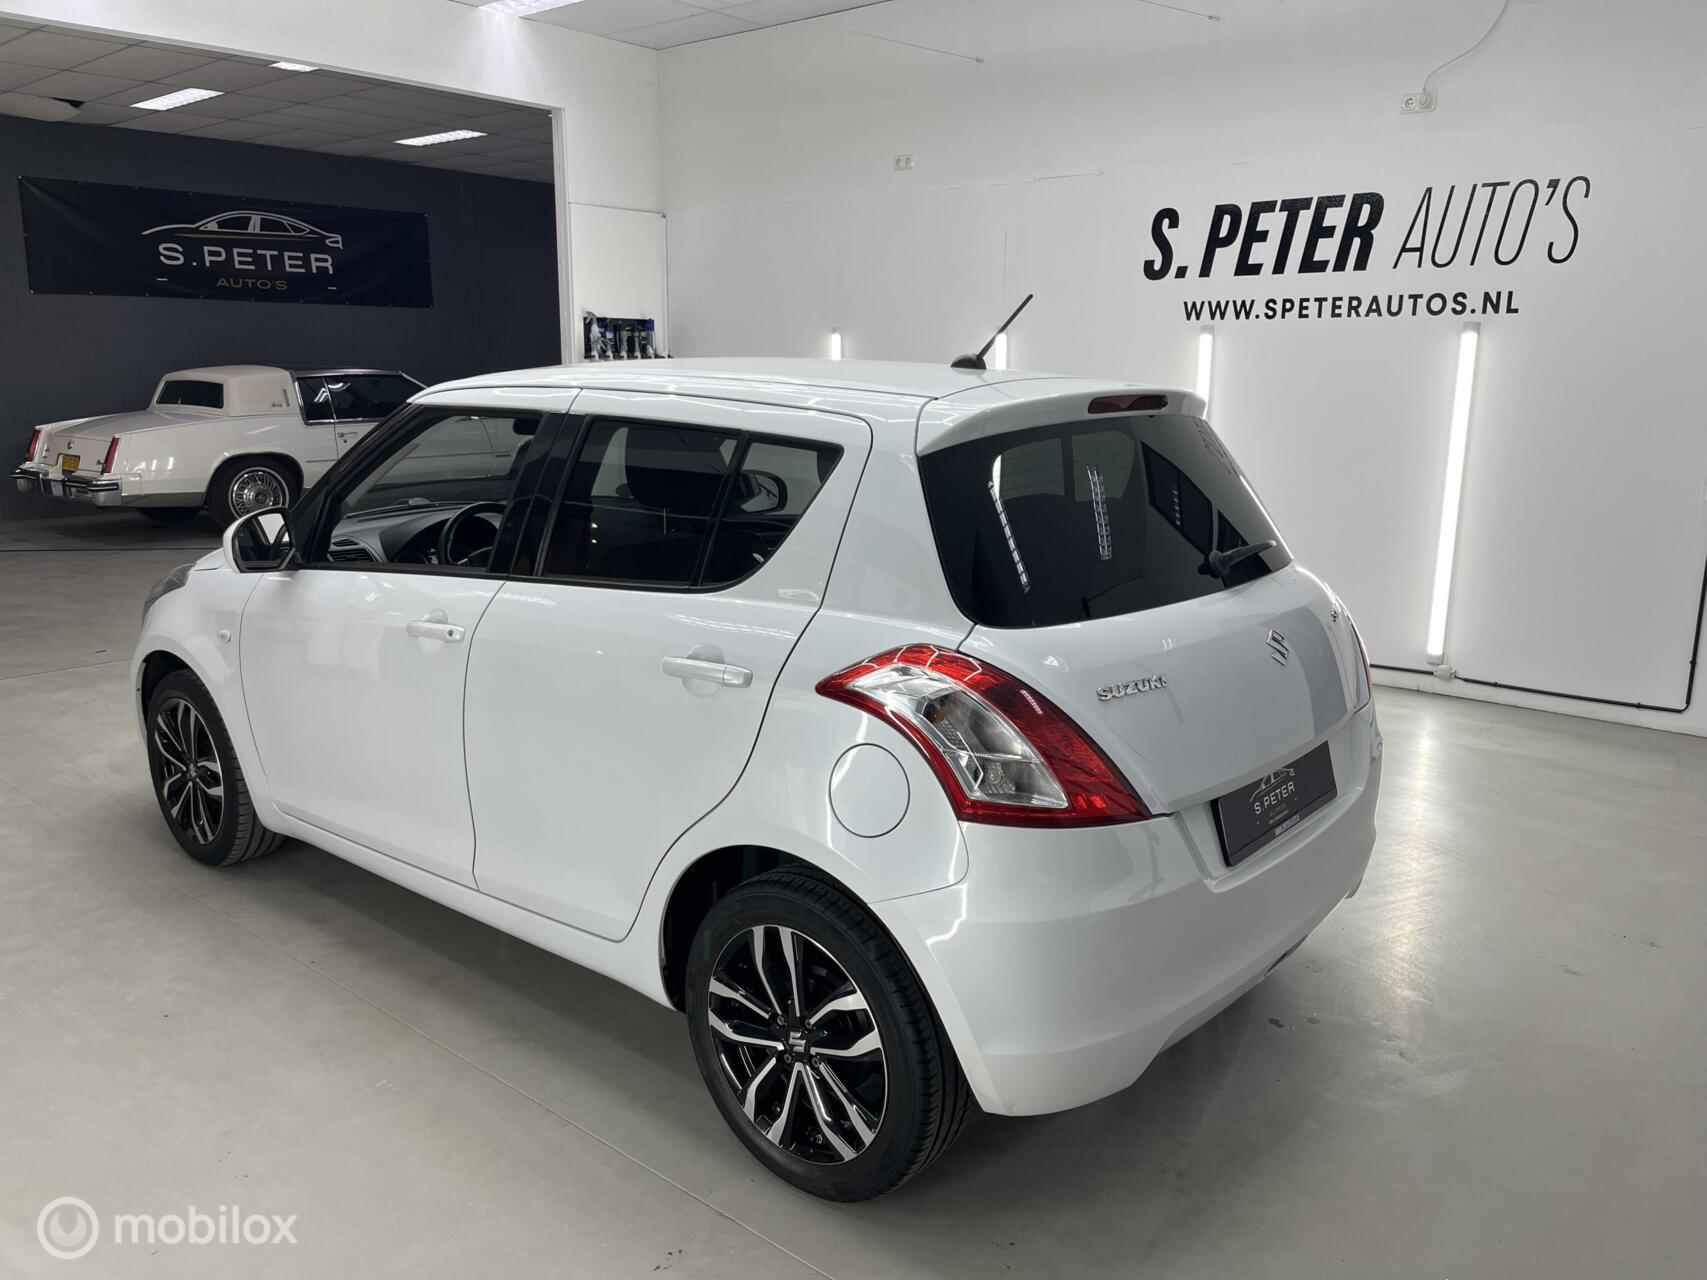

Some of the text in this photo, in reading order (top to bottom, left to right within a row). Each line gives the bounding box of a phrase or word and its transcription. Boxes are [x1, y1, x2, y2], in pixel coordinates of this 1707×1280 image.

[1198, 191, 1385, 278] PETER
[1392, 175, 1591, 270] AUTO'S
[215, 276, 288, 291] AUTO'S
[1183, 290, 1520, 322] WWW.SPETERAUTOS.NL
[1097, 674, 1168, 702] SUZUKI
